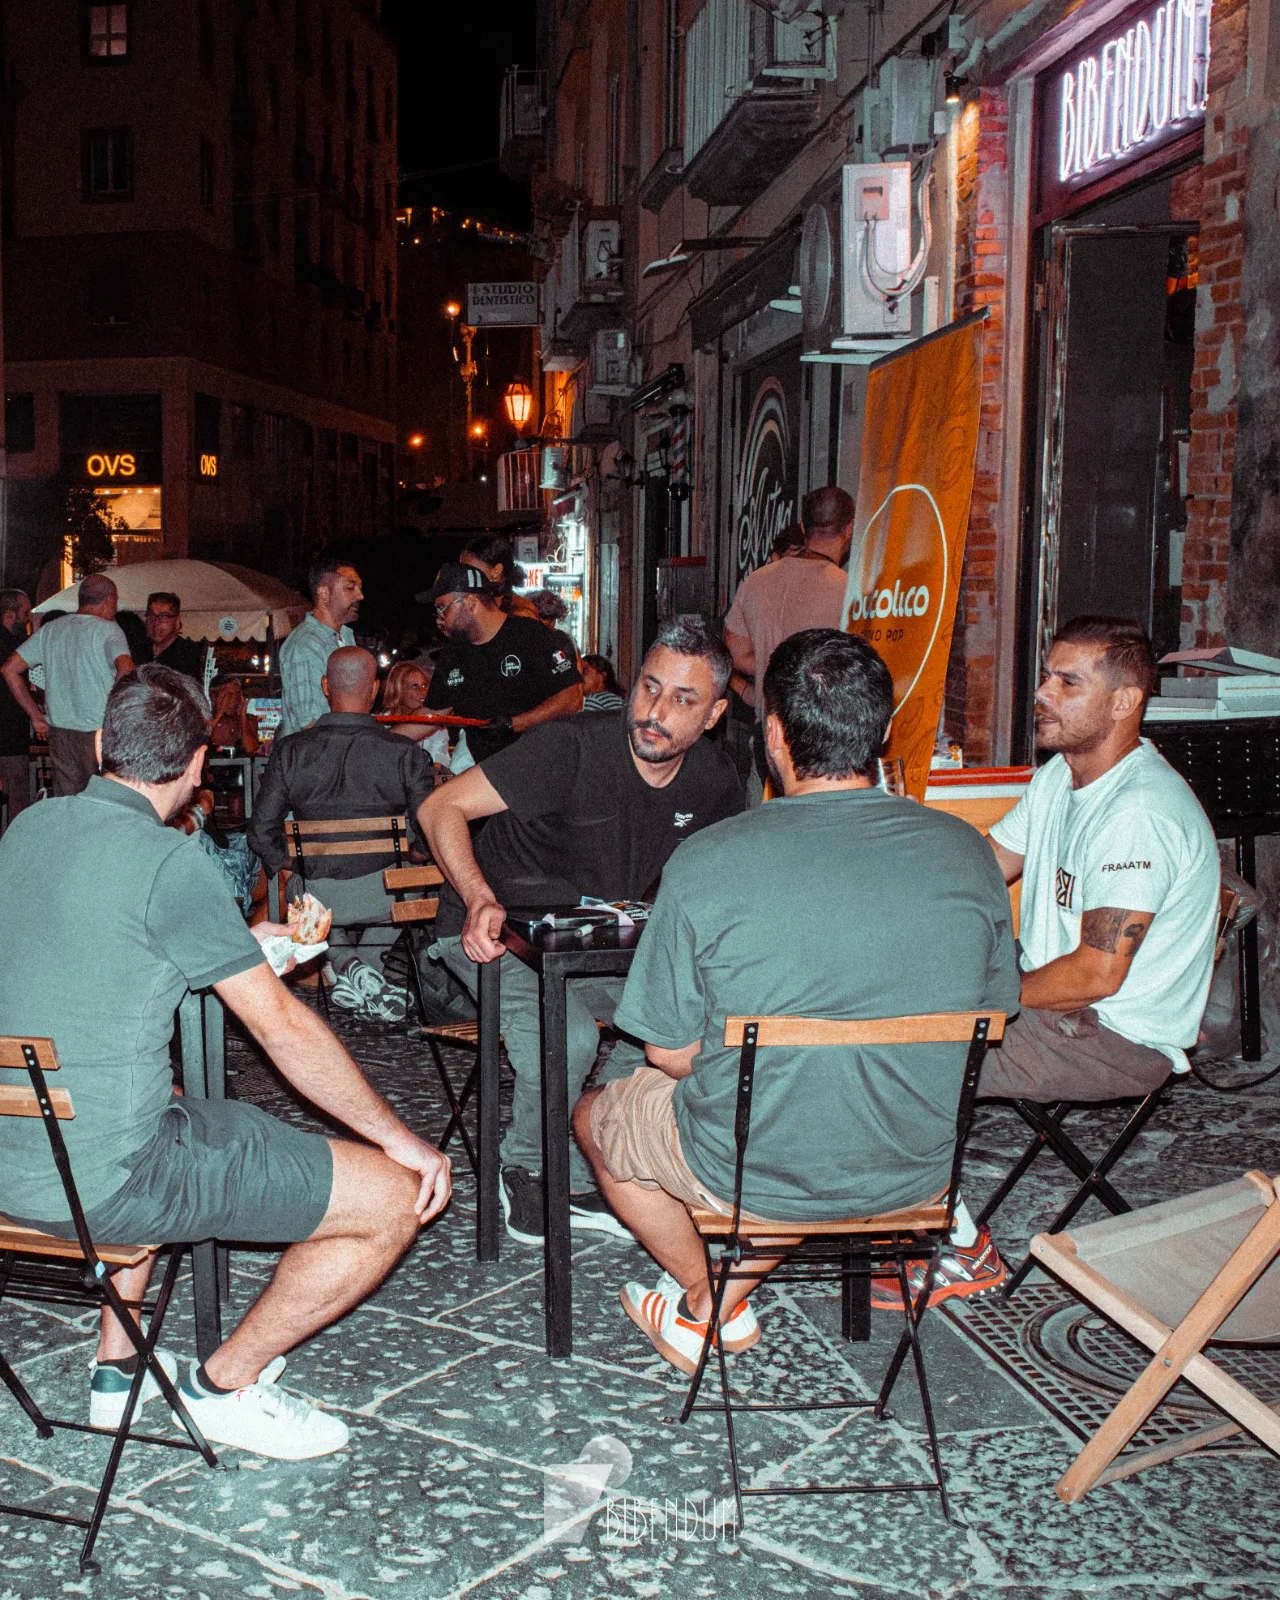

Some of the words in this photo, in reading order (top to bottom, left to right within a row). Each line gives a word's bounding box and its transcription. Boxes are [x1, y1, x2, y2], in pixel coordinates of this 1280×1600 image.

[482, 284, 533, 295] STUDIO
[472, 295, 535, 305] DENTISTICO
[87, 454, 136, 476] OVS
[200, 454, 217, 476] OVS
[886, 629, 904, 641] POP
